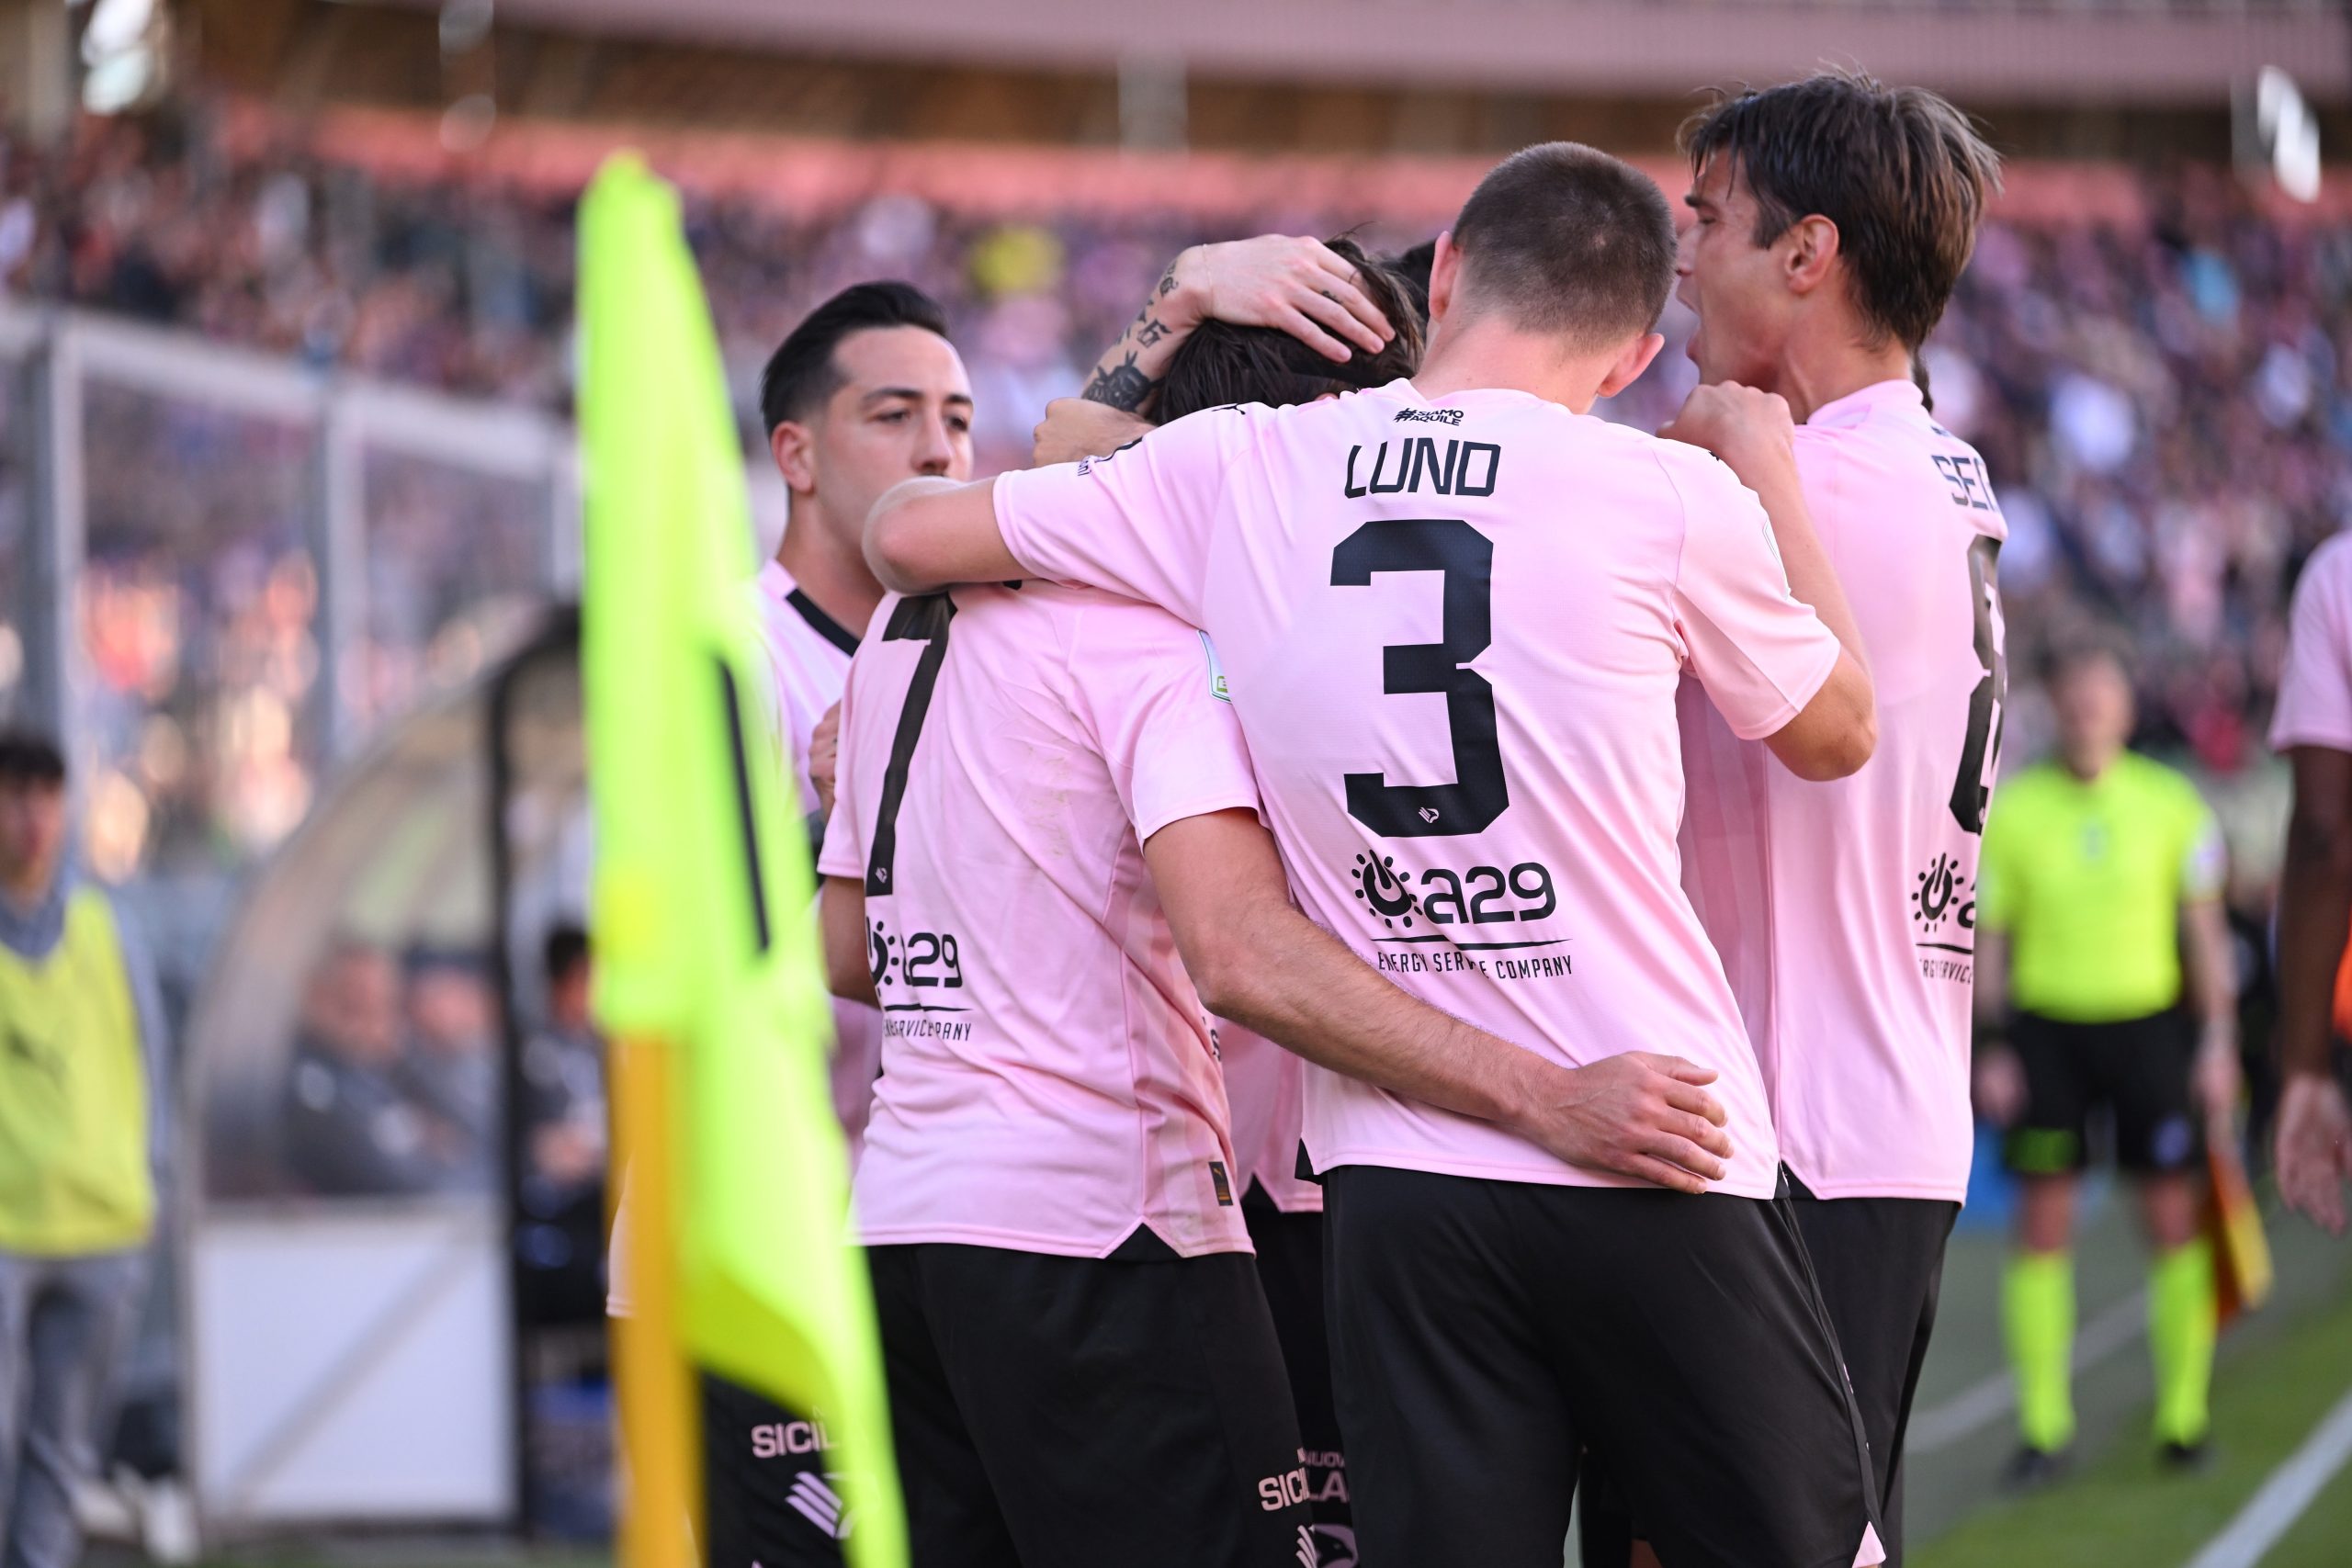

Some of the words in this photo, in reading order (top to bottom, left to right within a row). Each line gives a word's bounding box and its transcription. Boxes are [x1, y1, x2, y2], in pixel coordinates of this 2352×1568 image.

[1344, 437, 1501, 499] LUND
[1329, 519, 1510, 837] 3
[865, 591, 958, 897] 7
[1420, 862, 1556, 925] a29
[1496, 954, 1572, 980] COMPANY
